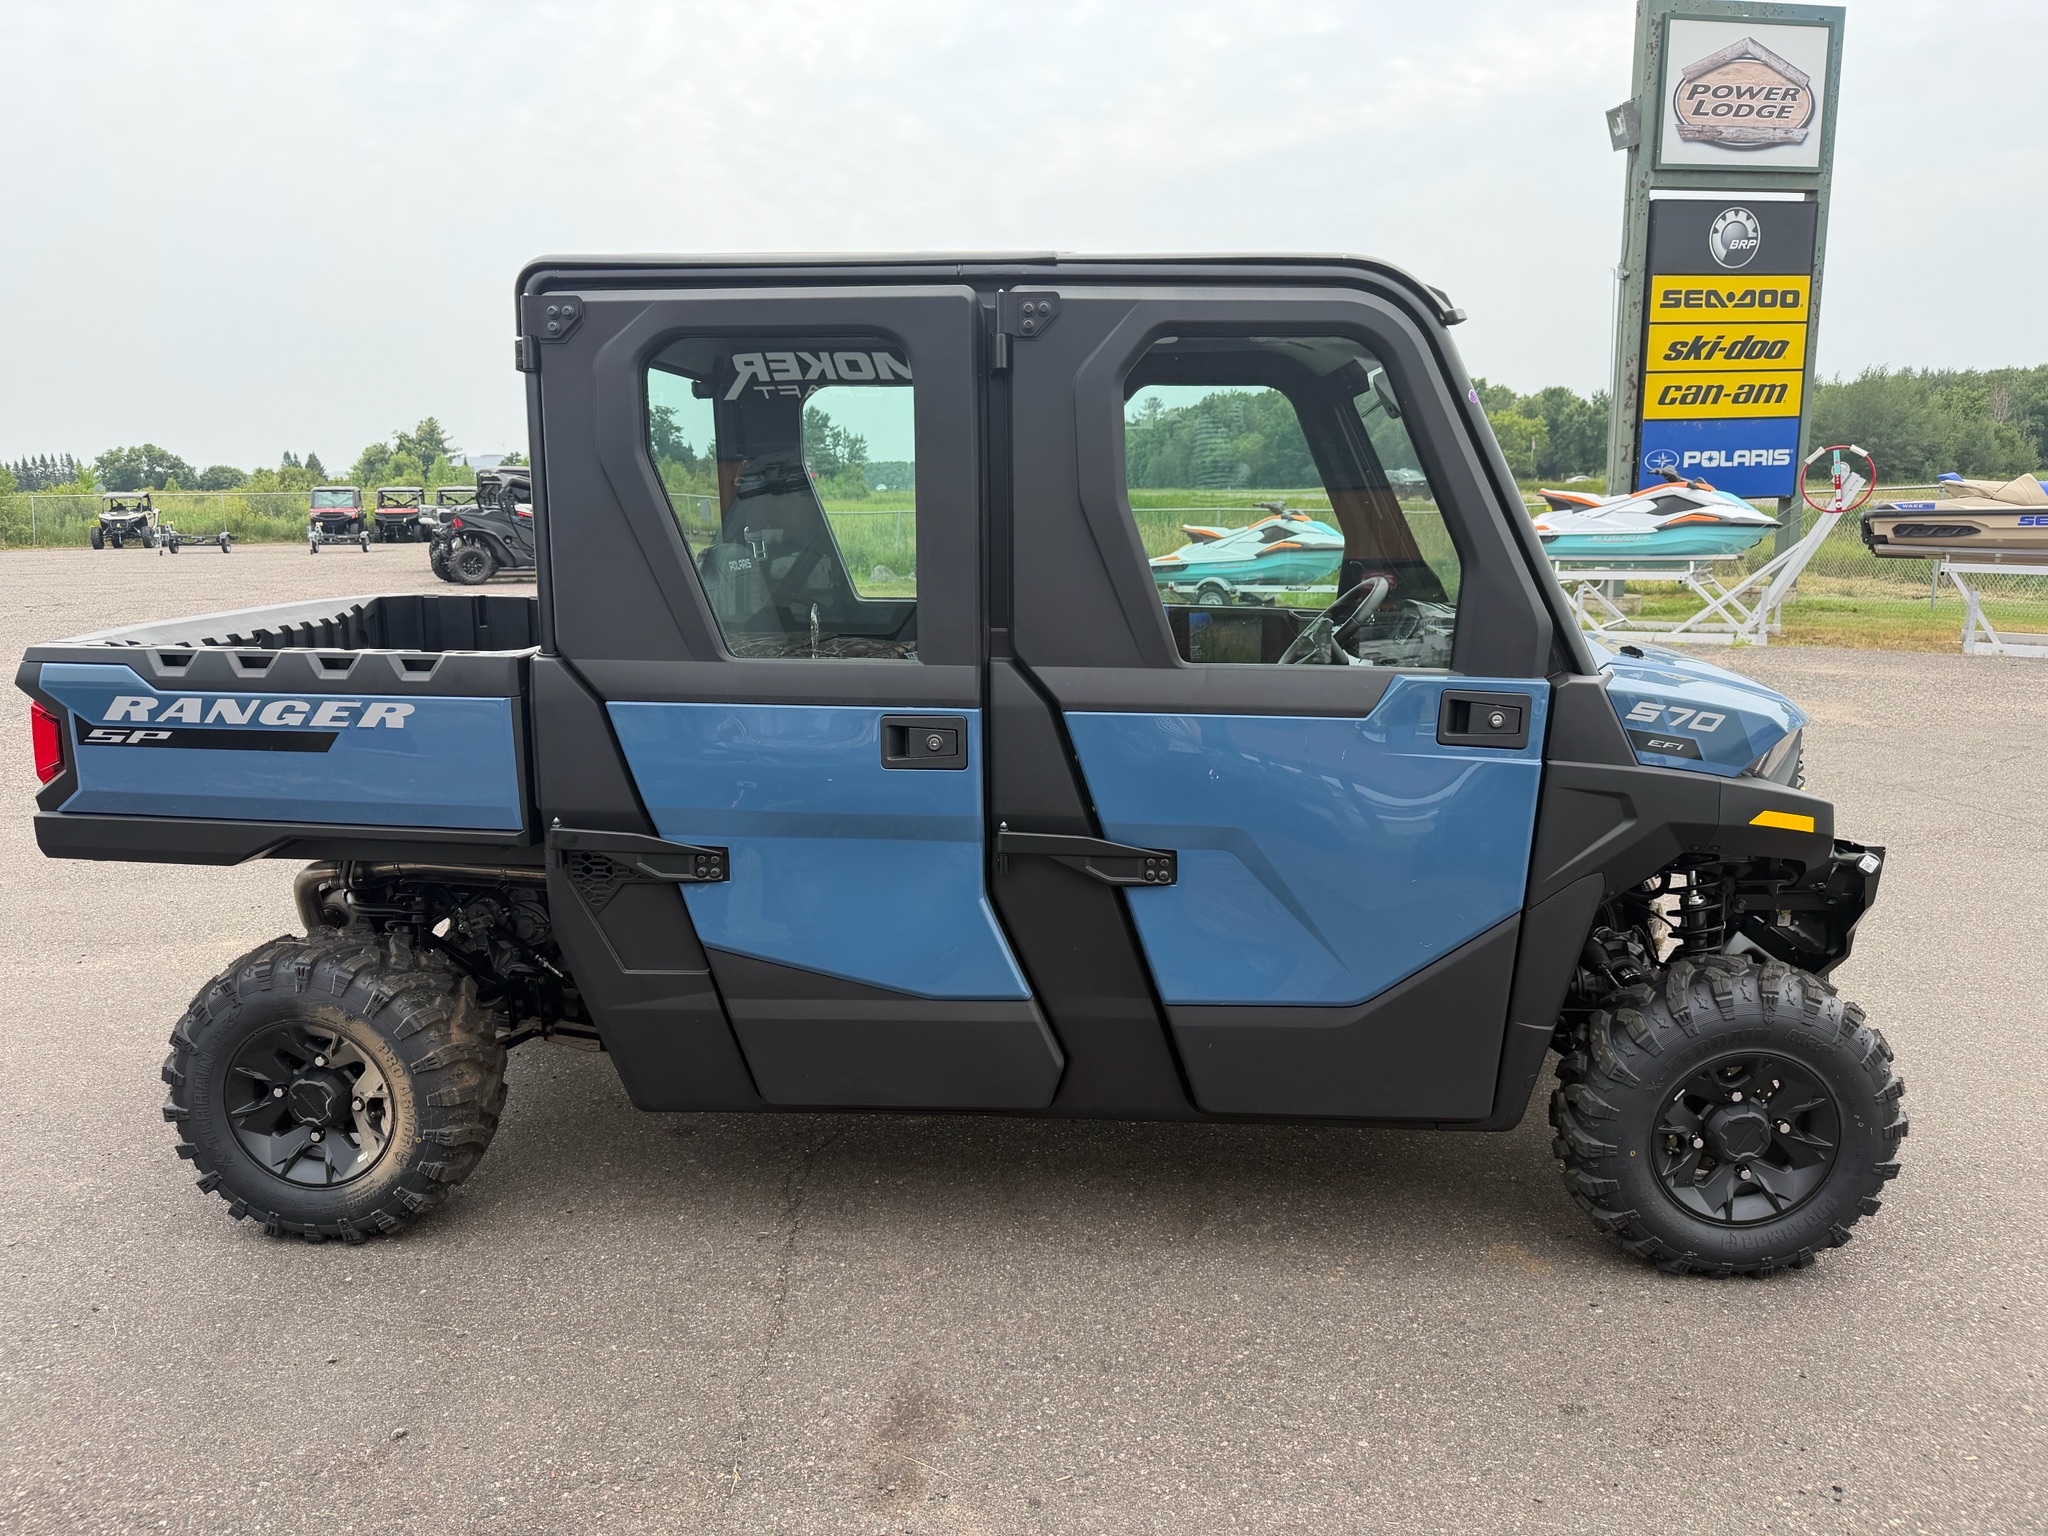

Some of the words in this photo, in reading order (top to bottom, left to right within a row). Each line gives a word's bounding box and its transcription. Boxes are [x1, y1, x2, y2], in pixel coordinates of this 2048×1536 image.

[1686, 83, 1801, 102] POWER
[1690, 99, 1795, 120] LODGE
[1729, 239, 1757, 250] BRP
[1662, 335, 1790, 361] ski-doo
[1657, 383, 1789, 406] can-am
[1683, 449, 1791, 468] POLARIS
[102, 695, 417, 729] RANGER
[1625, 701, 1727, 732] 570
[84, 728, 173, 744] SP
[1647, 739, 1685, 751] EFI
[376, 1040, 406, 1079] PRO
